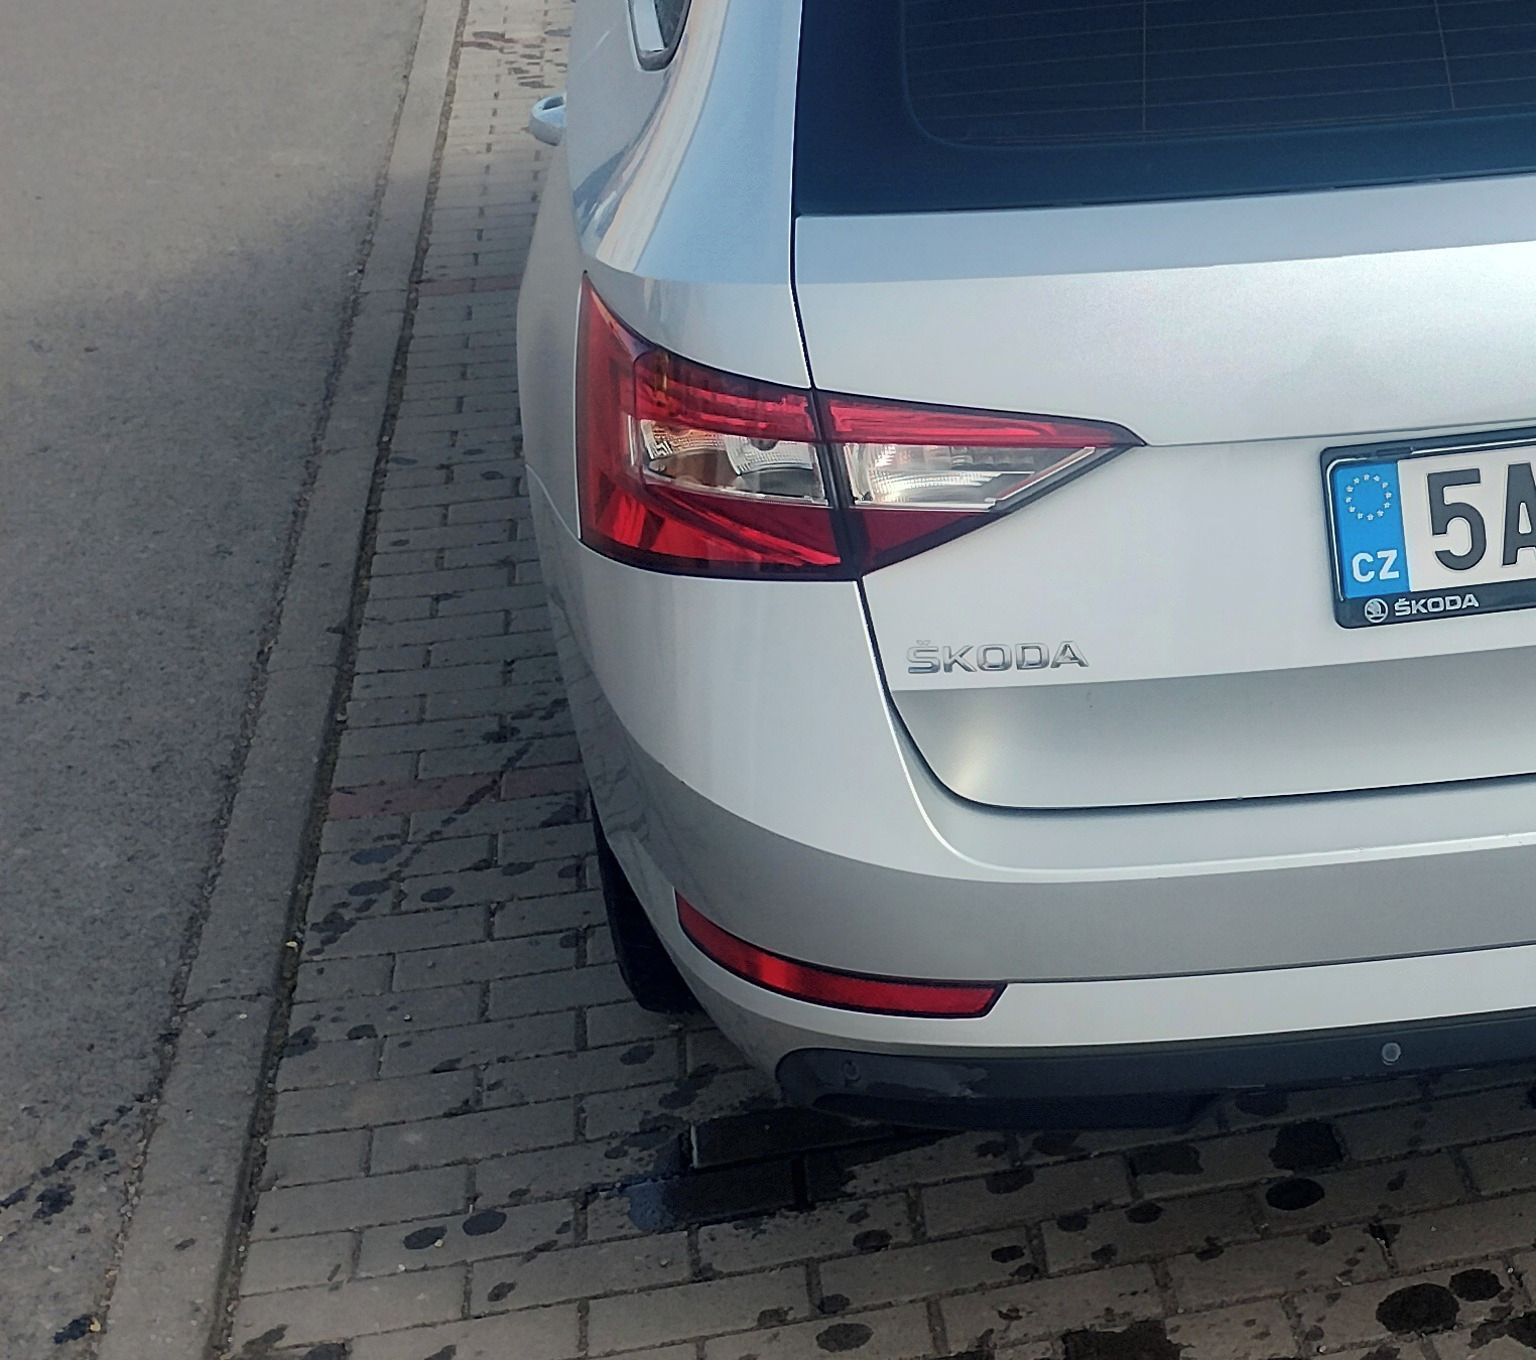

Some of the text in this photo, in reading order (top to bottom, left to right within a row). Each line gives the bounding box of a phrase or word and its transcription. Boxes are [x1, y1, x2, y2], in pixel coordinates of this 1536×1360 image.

[1351, 549, 1400, 583] CZ
[1394, 593, 1480, 616] ŠKODA
[906, 639, 1090, 675] ŠKODA
